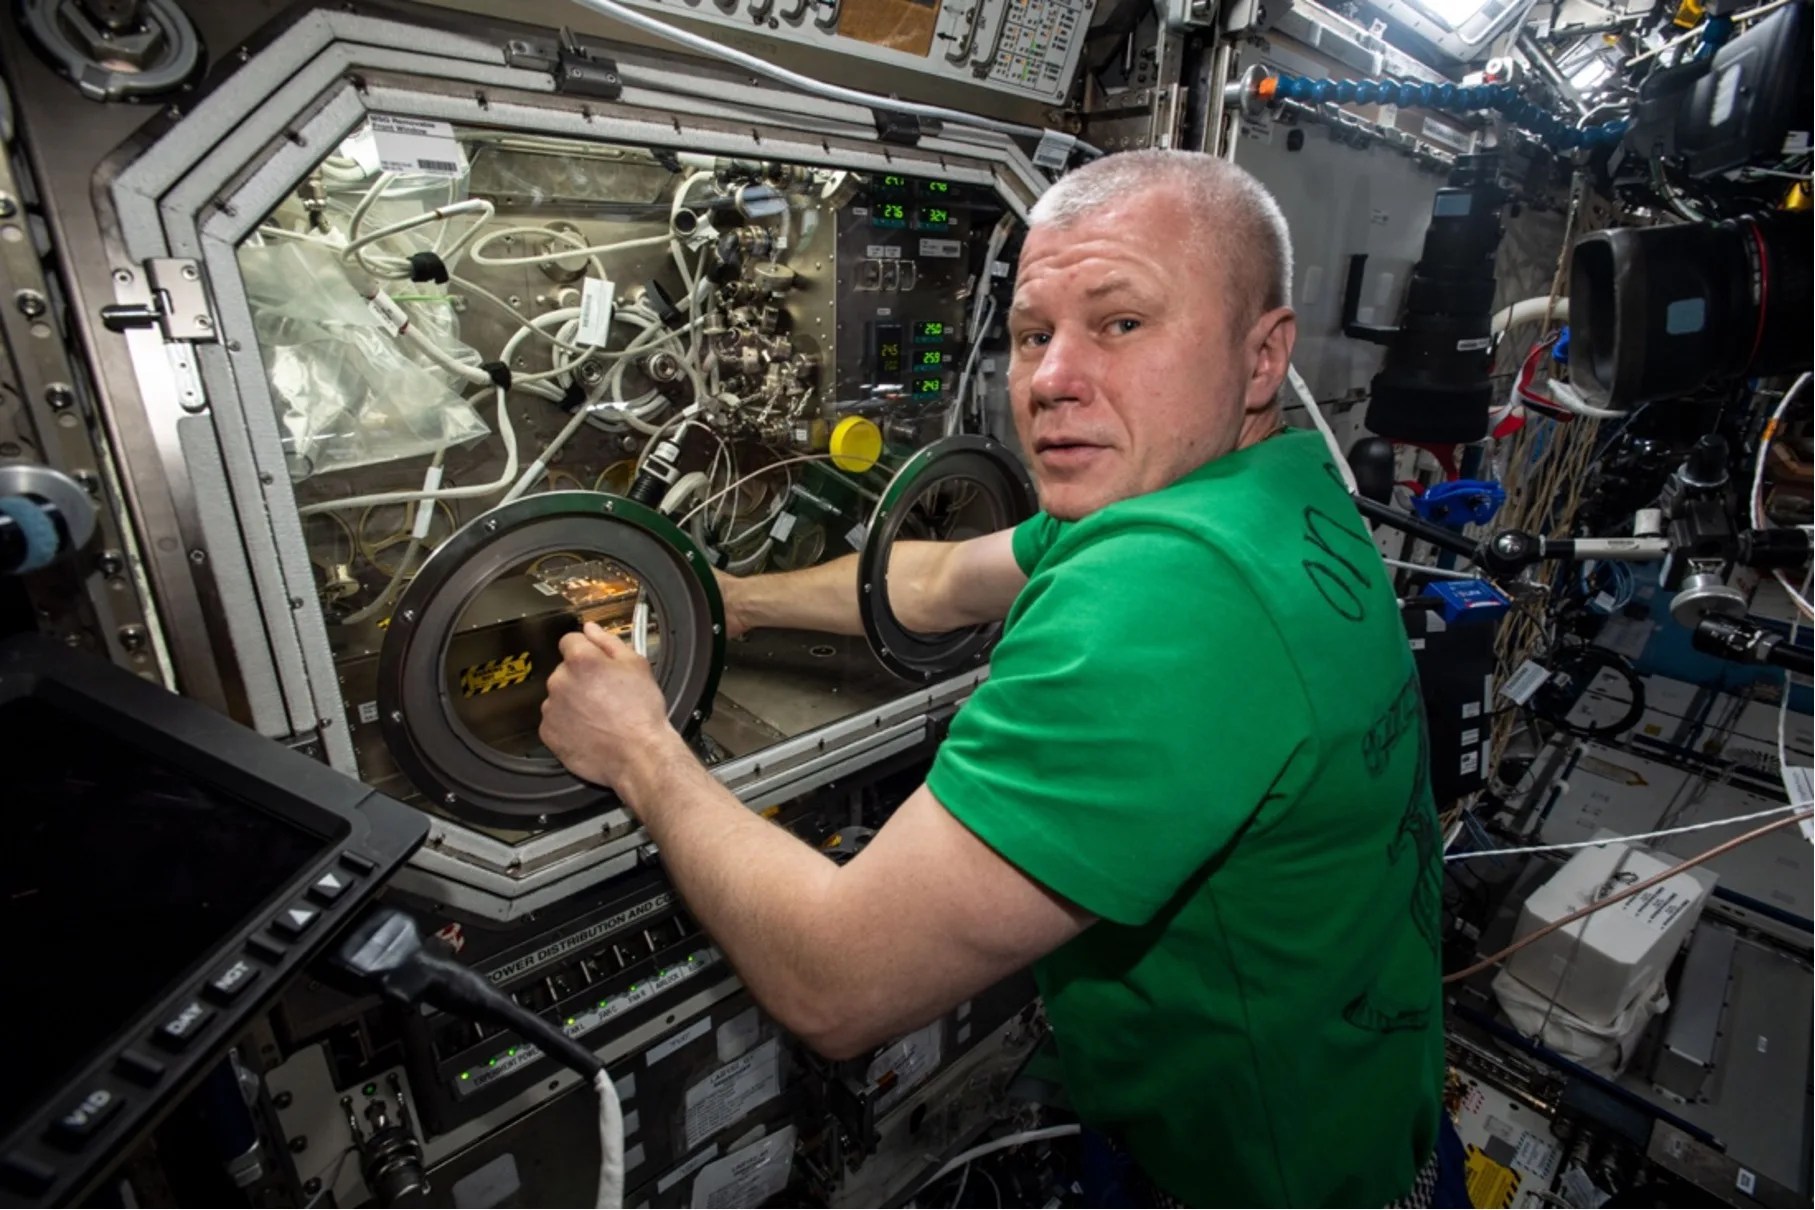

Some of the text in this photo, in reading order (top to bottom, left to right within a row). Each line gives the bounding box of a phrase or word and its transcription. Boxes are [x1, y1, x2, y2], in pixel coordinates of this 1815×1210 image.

[372, 122, 427, 135] Front Window
[392, 117, 436, 129] Removable
[537, 913, 627, 961] DISTRIBUTION
[627, 902, 654, 920] AND
[164, 1001, 204, 1035] DAY
[63, 1089, 112, 1126] VID
